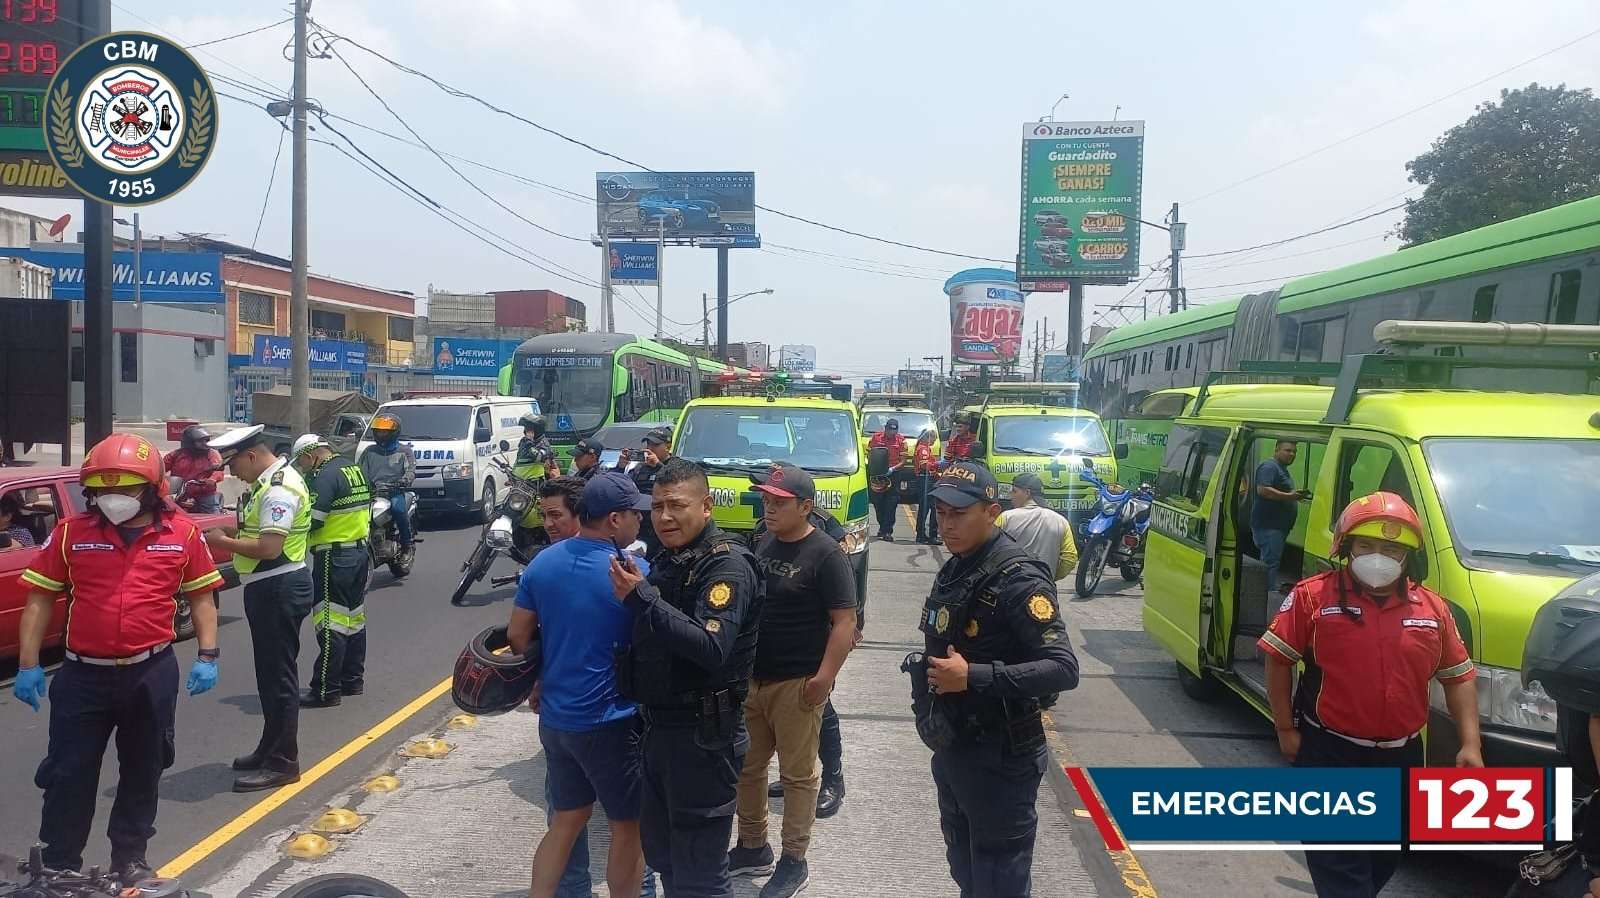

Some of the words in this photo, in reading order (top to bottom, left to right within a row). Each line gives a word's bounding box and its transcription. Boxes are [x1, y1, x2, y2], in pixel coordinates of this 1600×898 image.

[1055, 126, 1092, 136] Banco
[1093, 125, 1135, 135] Azteca
[1048, 149, 1117, 161] Guardadito
[1058, 178, 1105, 191] GANAS!
[1032, 196, 1074, 205] AHORRA
[1075, 195, 1097, 204] cada
[1098, 195, 1133, 203] semana
[1086, 243, 1129, 254] CARROS
[952, 301, 1023, 342] Zagaz
[455, 347, 496, 358] SHERWIN
[994, 462, 1042, 474] BOMBEROS
